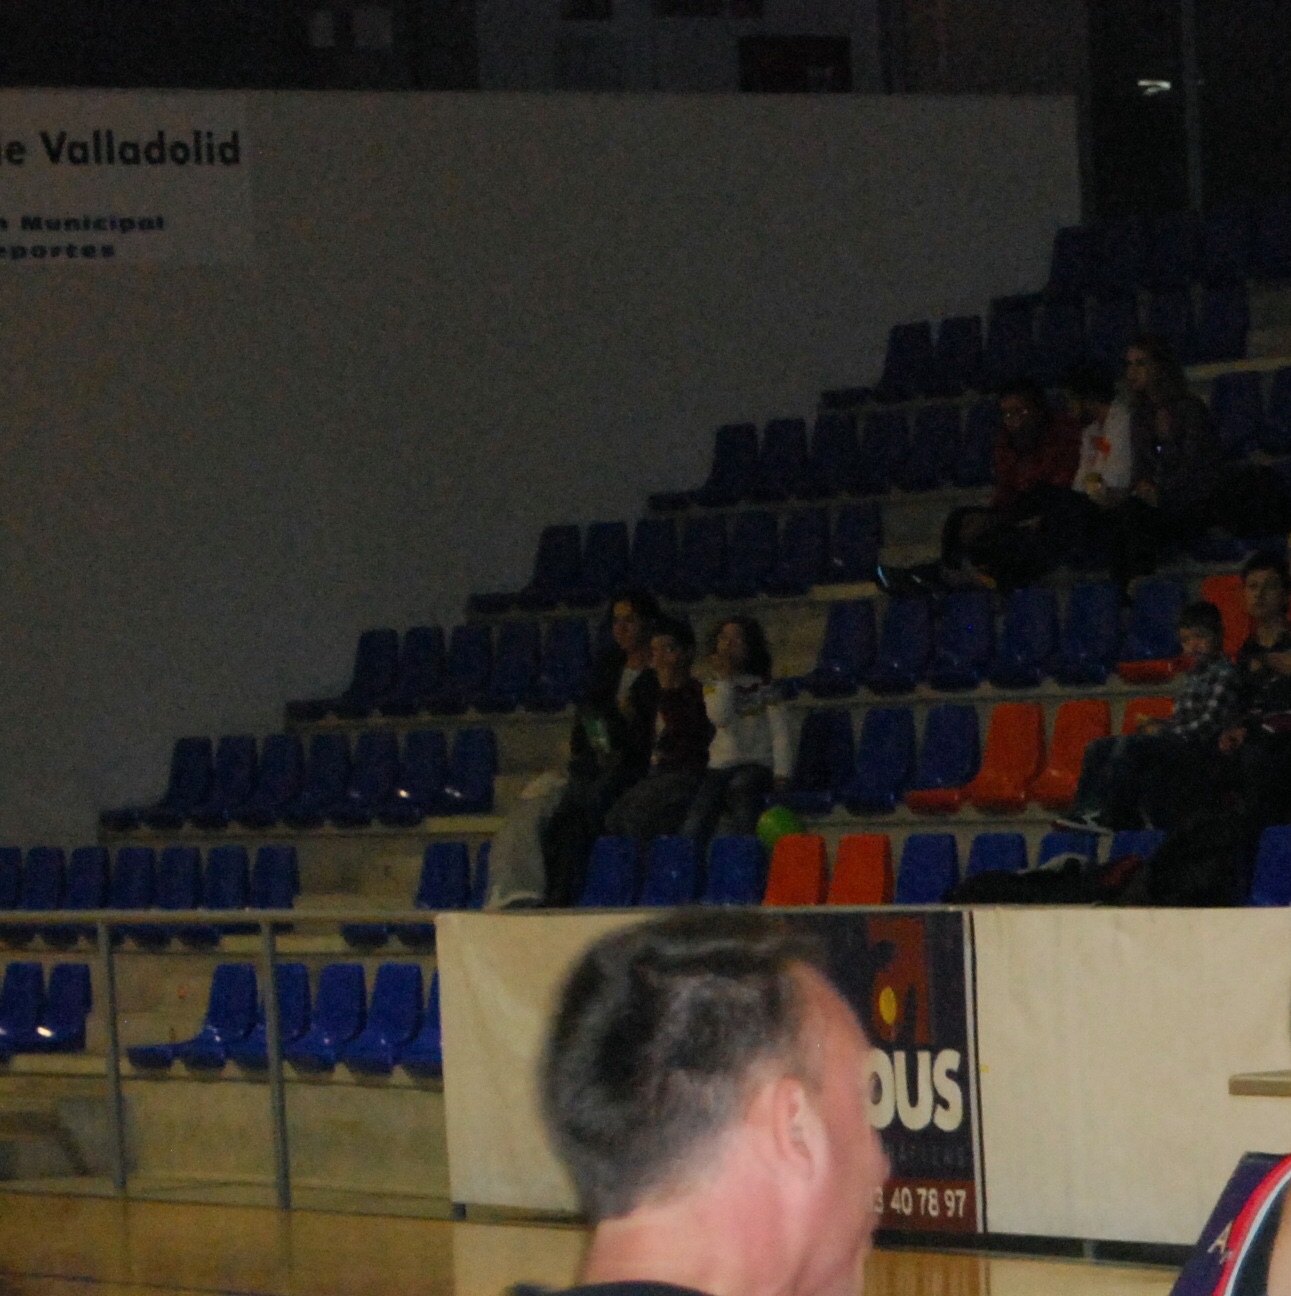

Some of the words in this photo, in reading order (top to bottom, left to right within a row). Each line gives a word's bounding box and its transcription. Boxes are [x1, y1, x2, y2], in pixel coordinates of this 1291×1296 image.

[0, 140, 26, 165] e
[39, 129, 241, 166] Valladolid
[21, 214, 165, 233] Municipal
[890, 1186, 913, 1216] 40
[916, 1188, 941, 1218] 78
[943, 1188, 967, 1218] 97
